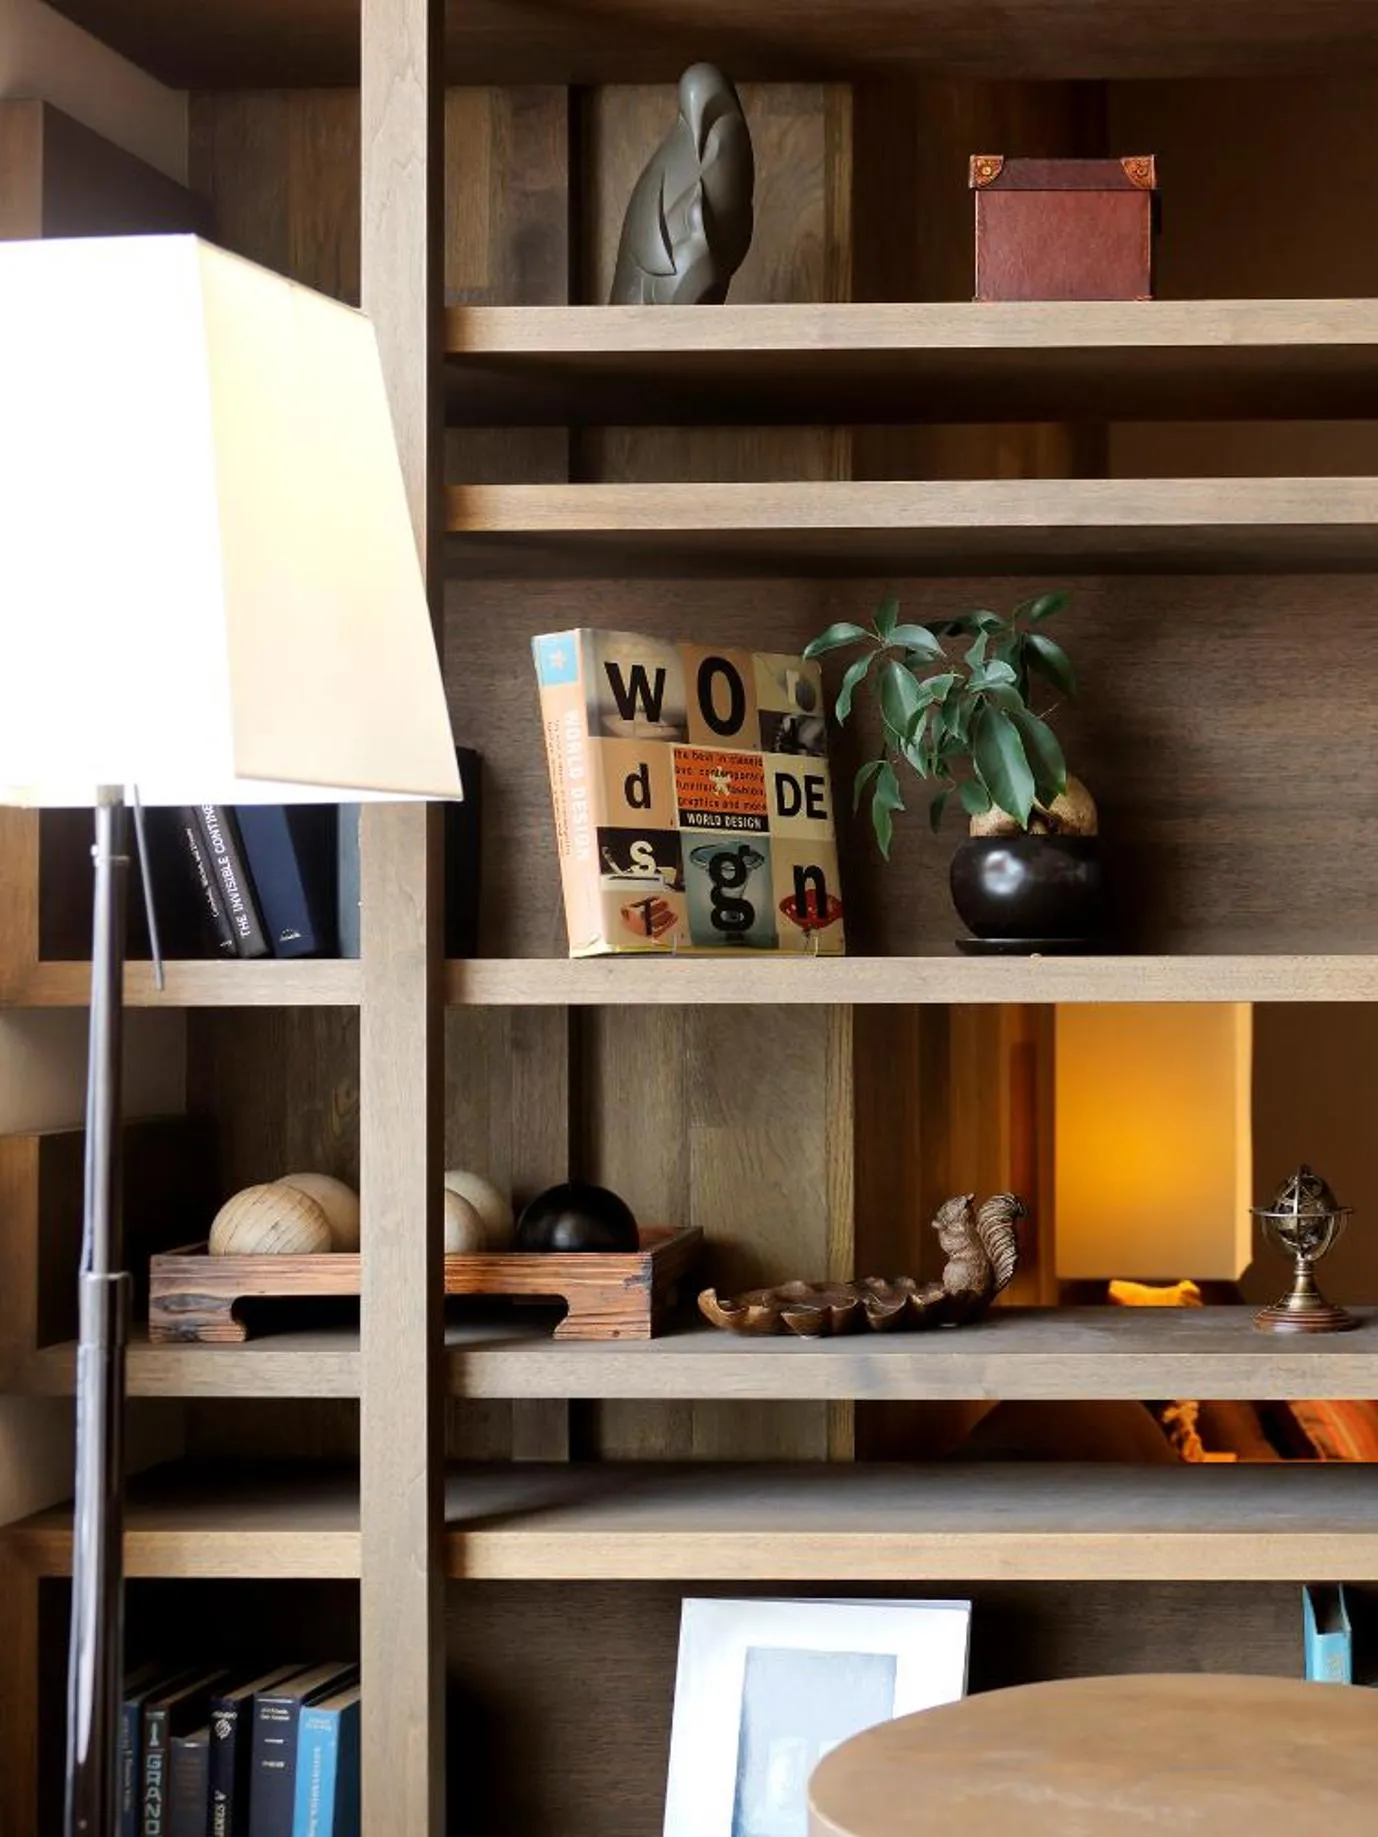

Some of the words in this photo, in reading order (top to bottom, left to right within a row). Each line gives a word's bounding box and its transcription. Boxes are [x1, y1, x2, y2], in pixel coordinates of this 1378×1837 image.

[565, 709, 585, 778] WORLD
[686, 812, 721, 826] WORLD
[725, 815, 762, 830] DESIGN
[774, 772, 828, 820] DE
[571, 785, 591, 862] DESIGN
[218, 855, 243, 913] INVISIBLE
[236, 913, 250, 939] THE
